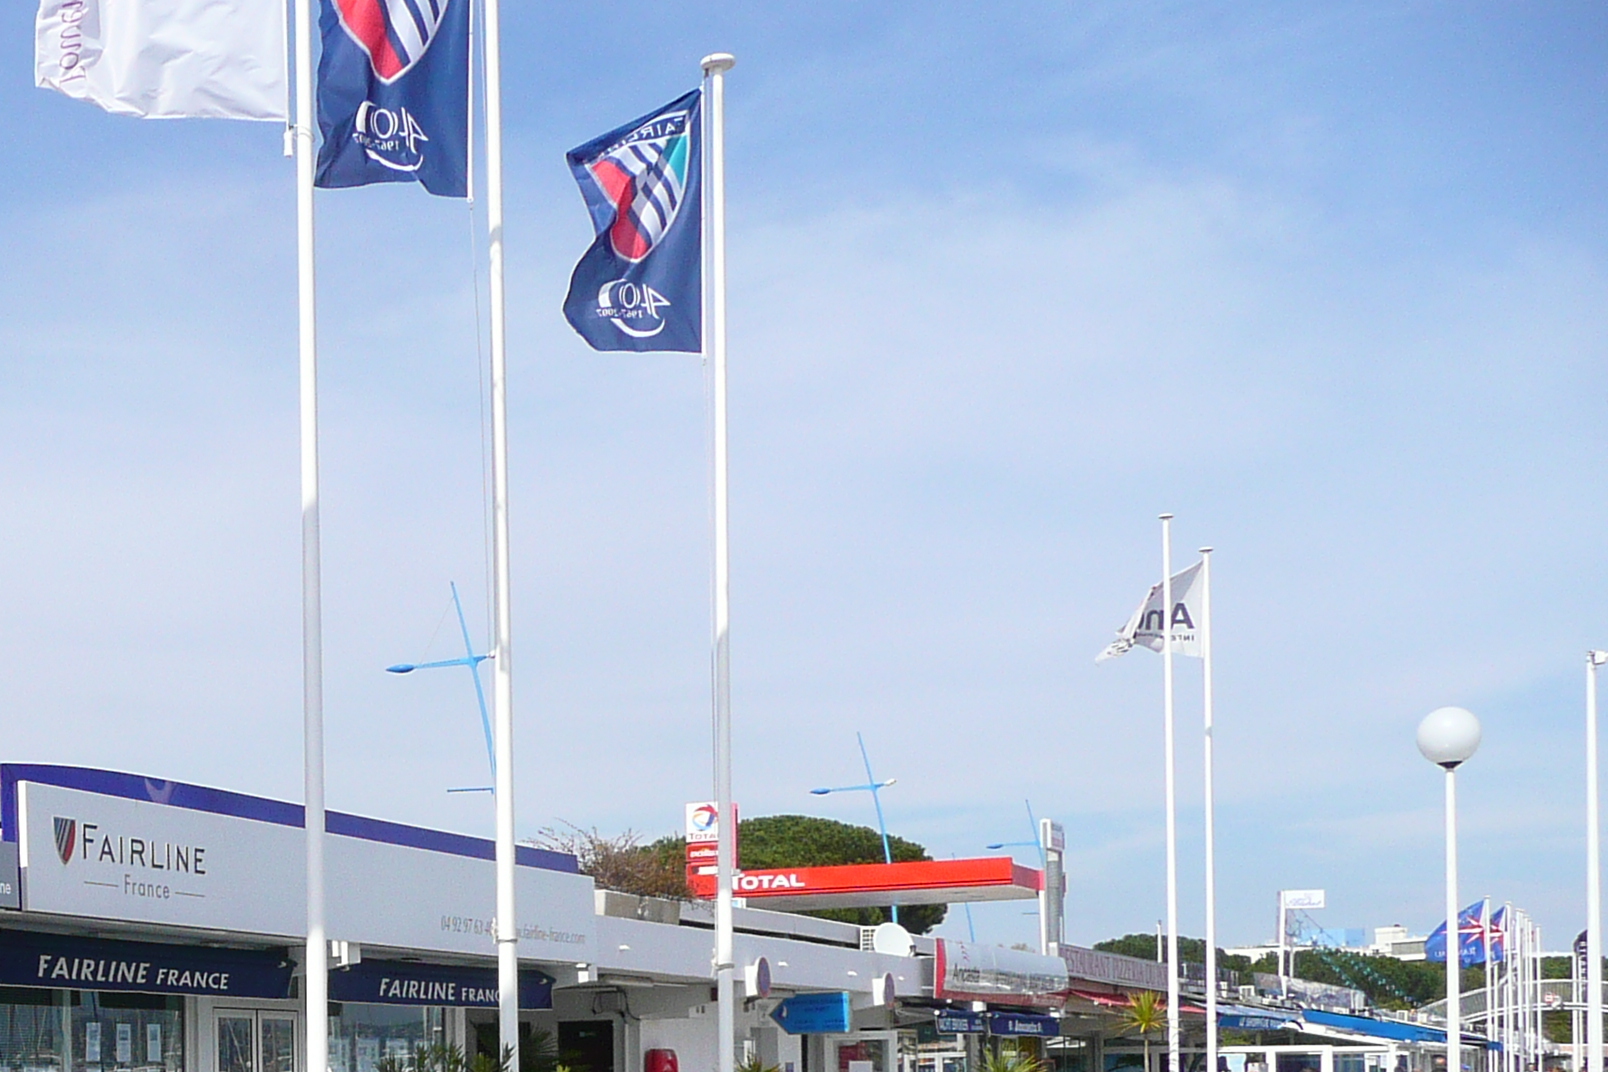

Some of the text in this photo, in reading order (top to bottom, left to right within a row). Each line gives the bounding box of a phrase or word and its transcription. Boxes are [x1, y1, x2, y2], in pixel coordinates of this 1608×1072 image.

[688, 832, 719, 841] TOTA
[82, 822, 206, 875] FAIRLINE
[124, 873, 171, 899] France
[731, 873, 806, 891] TOTAL
[441, 915, 451, 932] 04
[452, 916, 462, 933] 92
[37, 954, 230, 990] FAIRLINE FRANCE
[379, 977, 456, 1000] FAIRLINE
